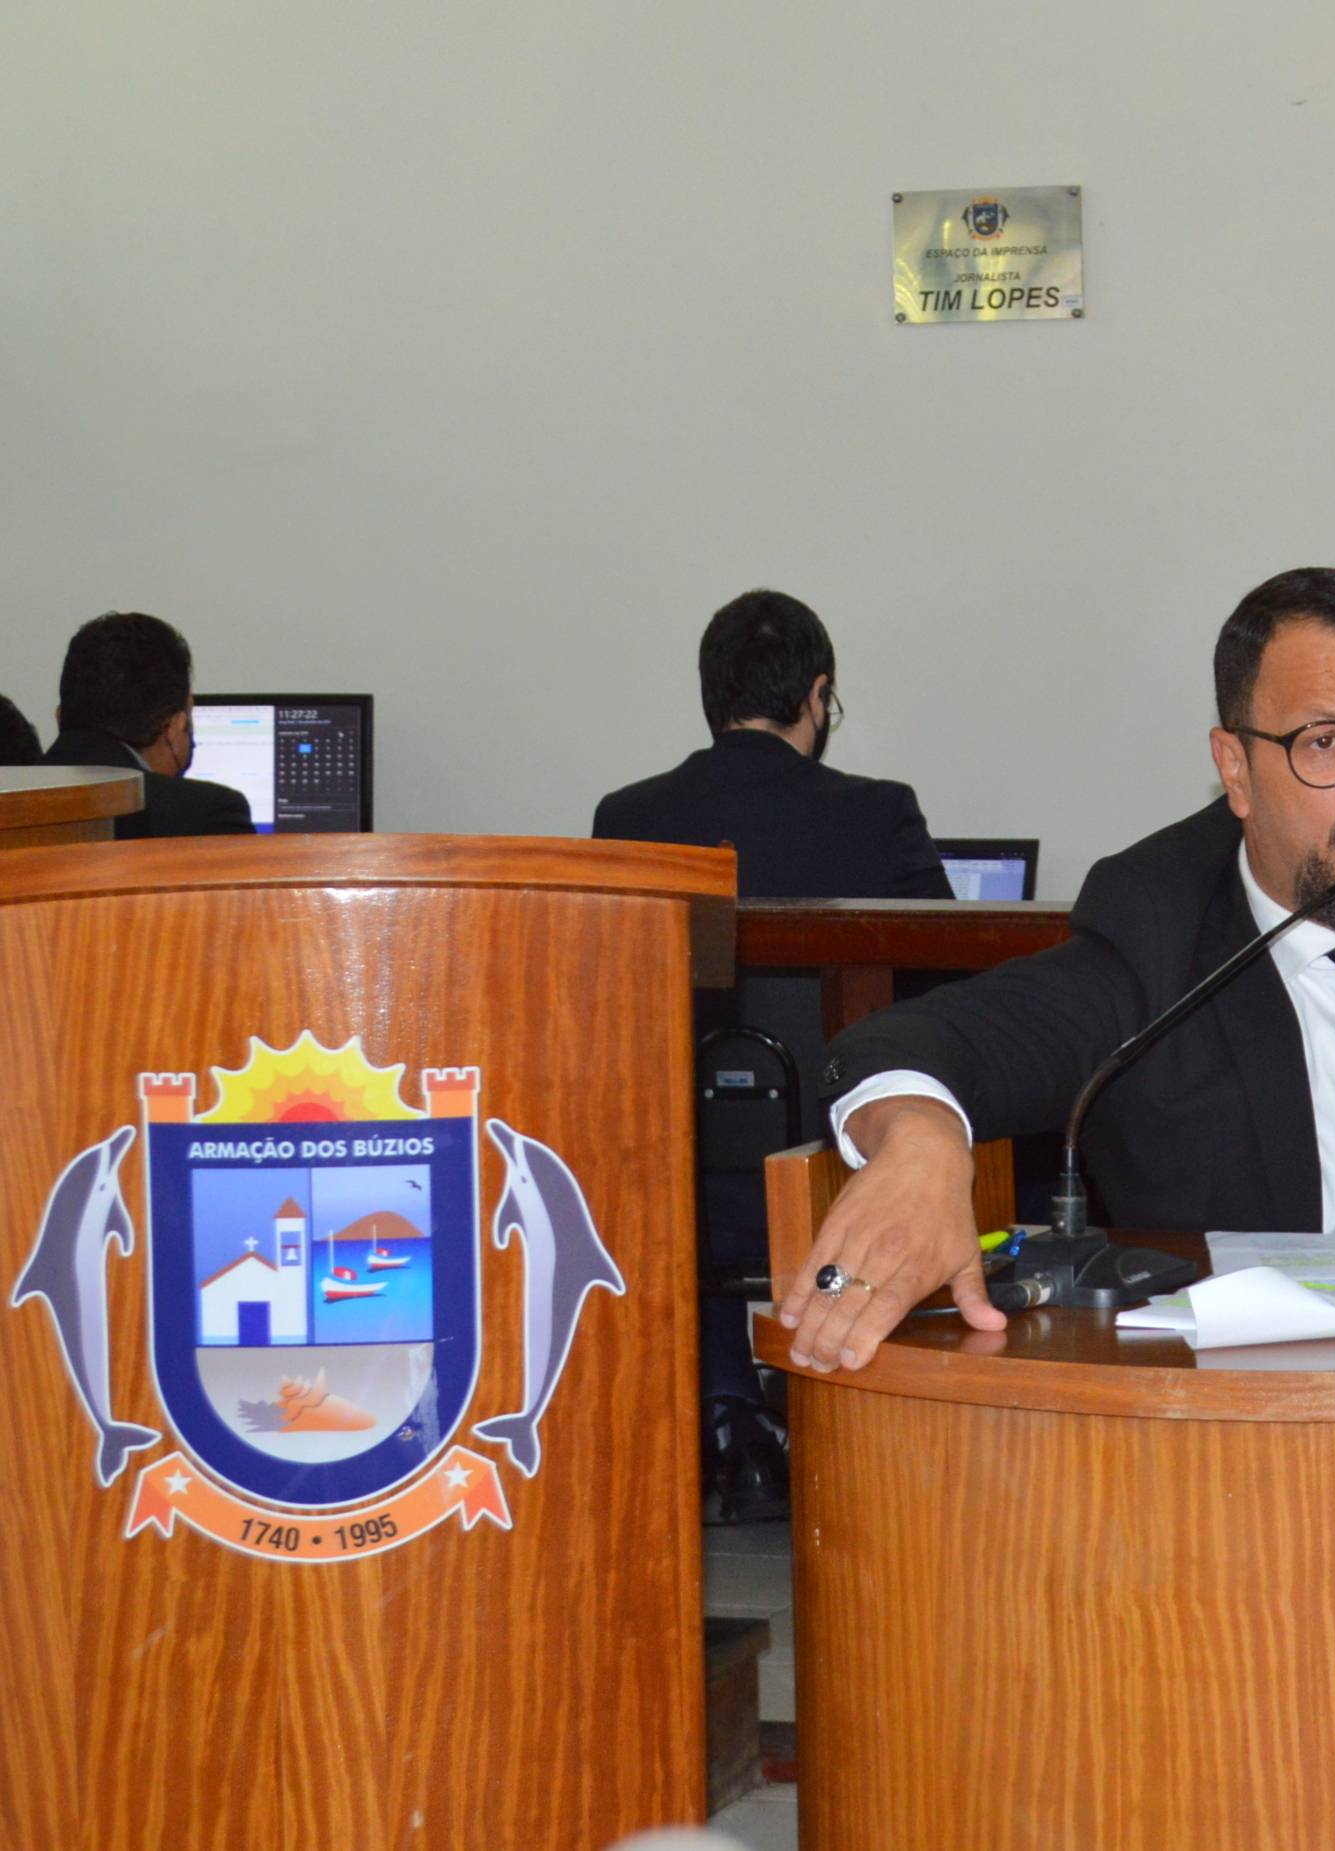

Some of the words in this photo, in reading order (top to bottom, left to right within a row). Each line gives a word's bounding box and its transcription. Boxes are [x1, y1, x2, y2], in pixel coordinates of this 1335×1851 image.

[926, 248, 969, 259] ESPAÇO
[973, 247, 988, 257] DA
[991, 245, 1048, 256] IMPRENSA
[954, 272, 1021, 283] JORNALISTA
[919, 289, 962, 311] TIM
[970, 286, 1061, 310] LOPES
[188, 1137, 295, 1163] ARMAÇÃO
[302, 1139, 348, 1159] DOS
[353, 1134, 435, 1157] BÚZIOS
[241, 1518, 300, 1551] 1740
[334, 1513, 398, 1550] 1995
